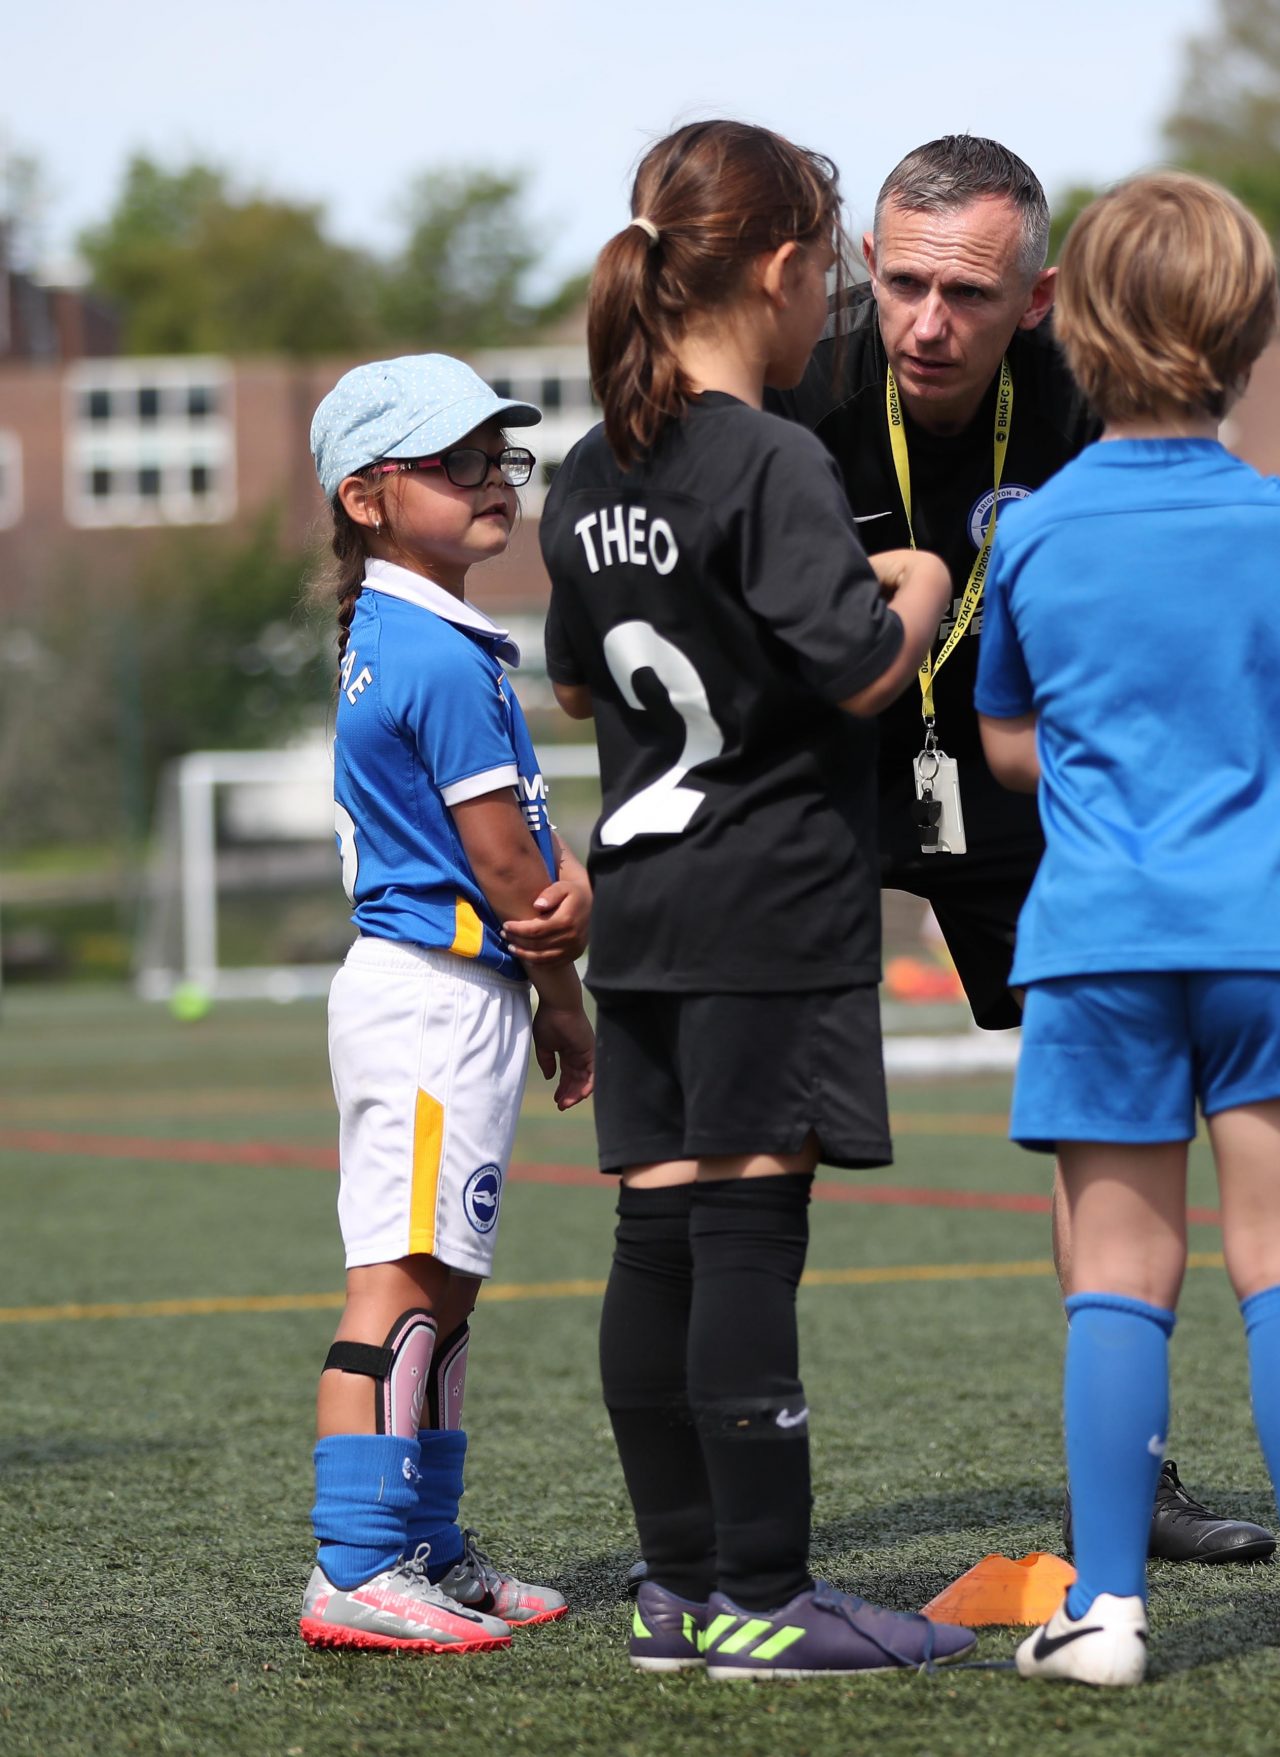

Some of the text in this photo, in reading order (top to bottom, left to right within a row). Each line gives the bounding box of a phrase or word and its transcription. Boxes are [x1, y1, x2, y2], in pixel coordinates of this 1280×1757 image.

[998, 389, 1010, 428] BHAFC
[575, 505, 679, 575] THEO
[937, 631, 960, 665] BHAFC
[958, 596, 974, 630] STAFF
[601, 620, 724, 845] 2
